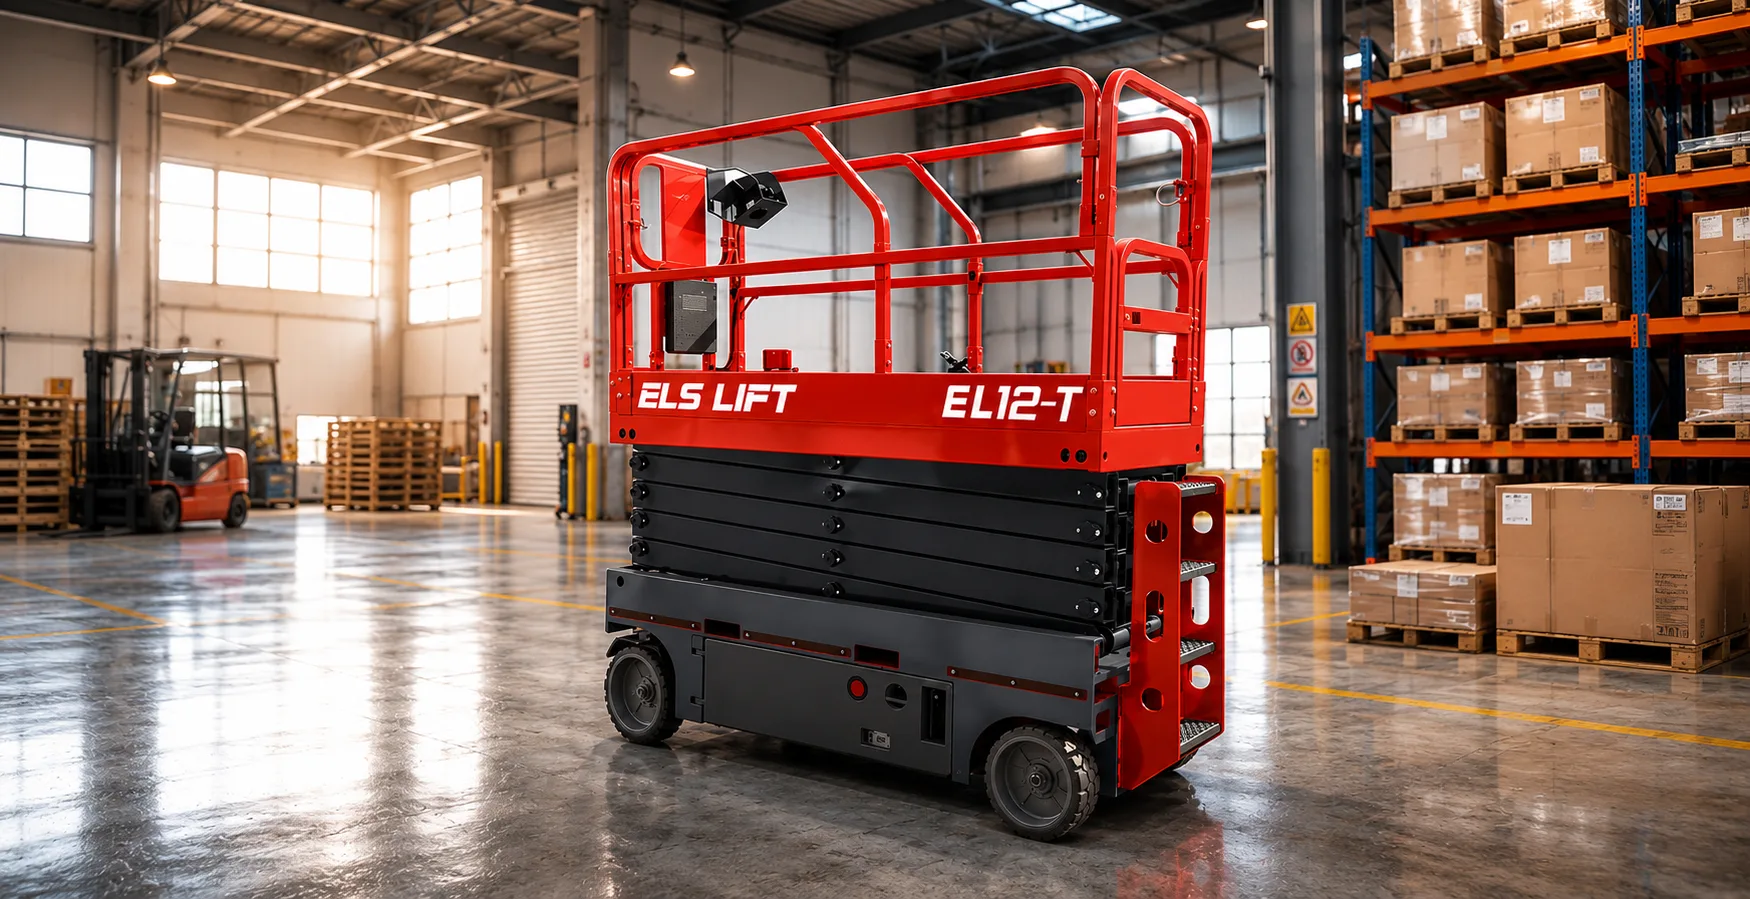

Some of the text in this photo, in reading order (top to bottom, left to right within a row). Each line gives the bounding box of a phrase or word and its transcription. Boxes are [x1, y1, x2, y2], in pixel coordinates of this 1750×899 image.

[637, 382, 798, 414] ELS LIFT
[941, 384, 1084, 422] EL12-T
